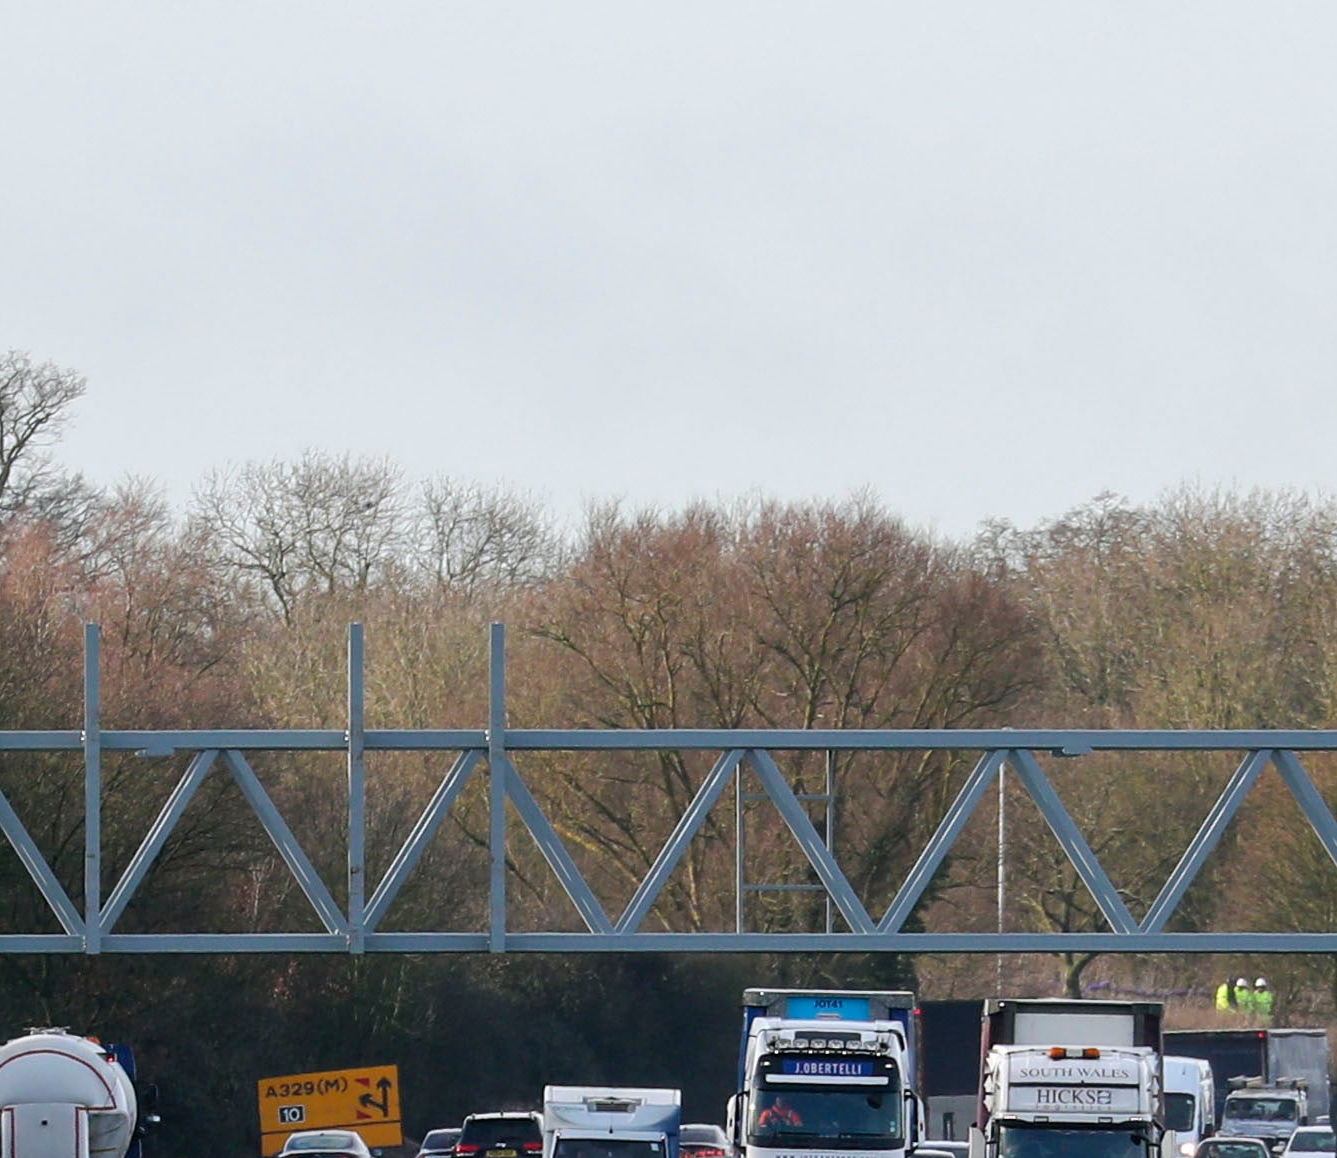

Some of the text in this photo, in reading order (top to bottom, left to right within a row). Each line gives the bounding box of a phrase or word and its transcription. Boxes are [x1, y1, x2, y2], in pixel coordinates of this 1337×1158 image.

[814, 999, 843, 1009] JOT41
[794, 1062, 862, 1074] J.OBERTELLI
[1020, 1067, 1130, 1079] SOUTH WALES
[265, 1077, 348, 1098] A329(M)
[1037, 1089, 1096, 1105] HICKS
[282, 1107, 301, 1122] 10
